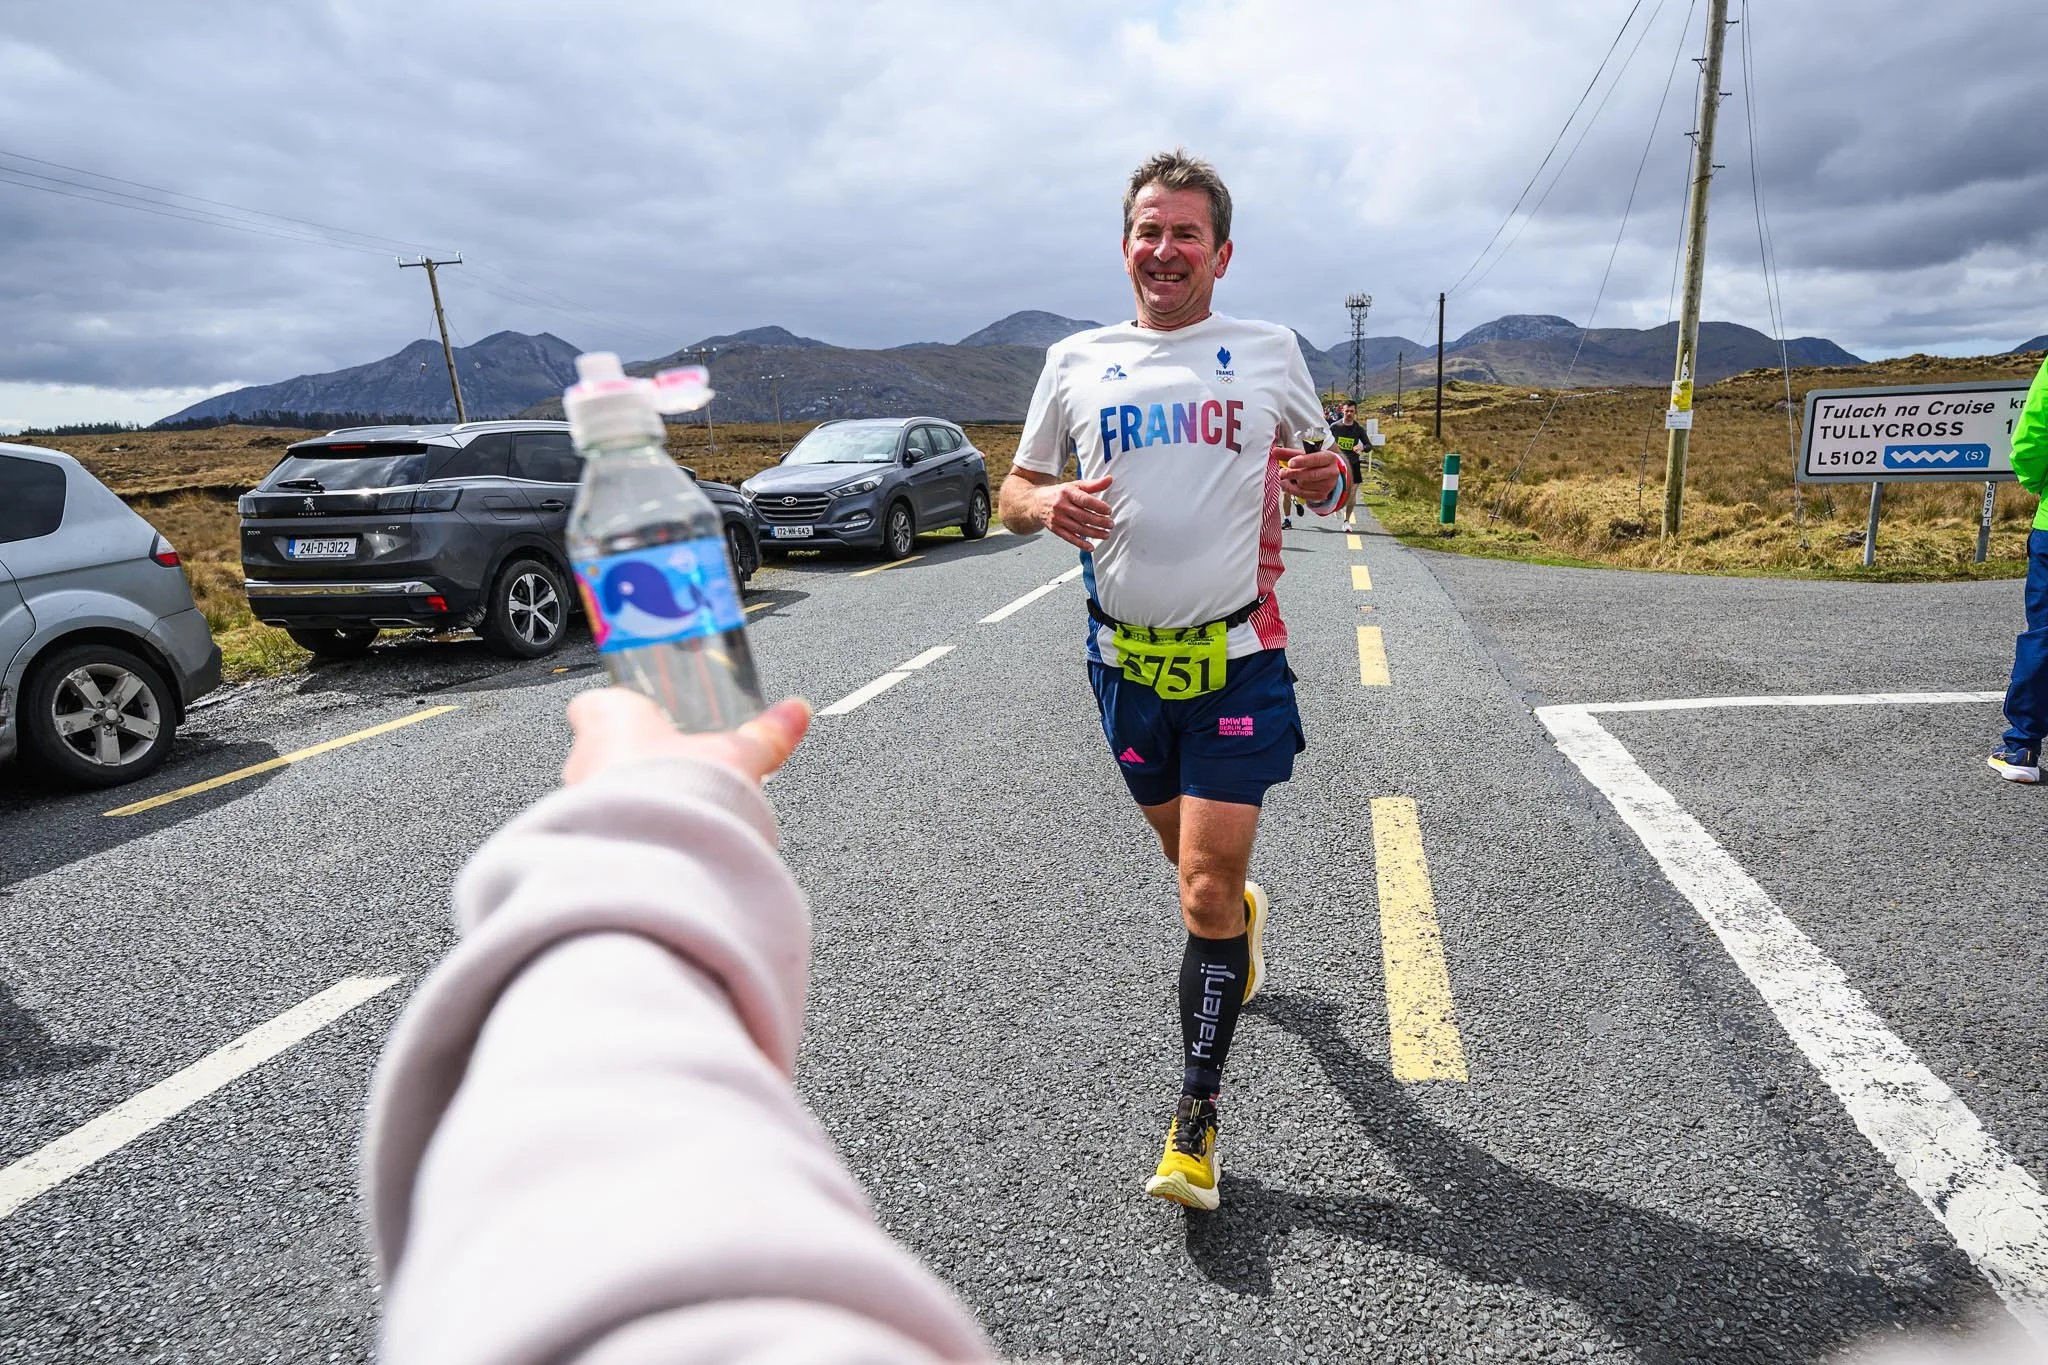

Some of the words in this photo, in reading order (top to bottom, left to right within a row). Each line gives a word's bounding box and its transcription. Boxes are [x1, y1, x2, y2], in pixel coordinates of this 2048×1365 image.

[1822, 403, 1887, 420] Tulach
[1895, 404, 1920, 417] na
[1928, 400, 1995, 416] Croise
[1100, 399, 1244, 464] FRANCE
[1820, 421, 1963, 439] TULLYCROSS
[1817, 450, 1878, 466] L5102
[1965, 450, 1984, 461] (S)
[300, 541, 350, 554] 241-D-13122
[1123, 653, 1213, 694] 5751
[1219, 717, 1241, 726] BMW
